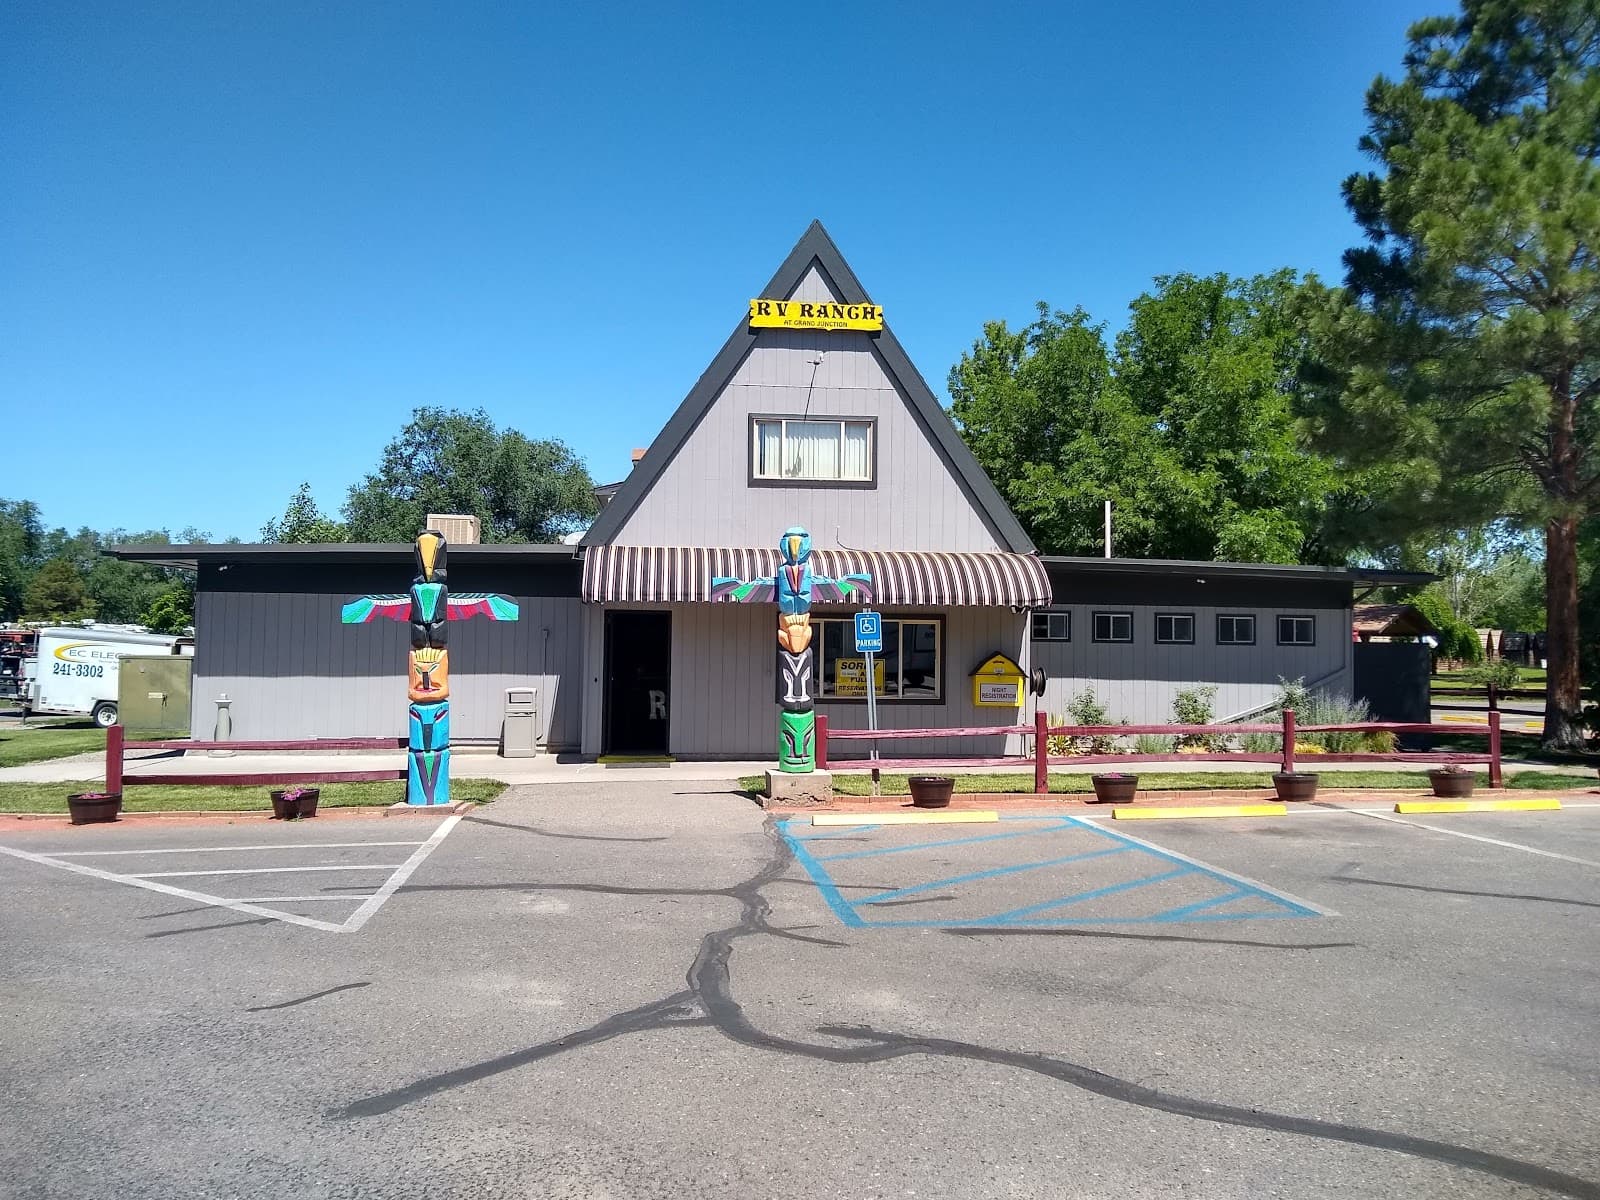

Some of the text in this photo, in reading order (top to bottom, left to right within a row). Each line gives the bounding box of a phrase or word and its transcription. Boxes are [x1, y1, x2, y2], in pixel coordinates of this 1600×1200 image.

[757, 302, 876, 320] RV RANCH
[69, 649, 87, 658] EC
[53, 662, 104, 678] 241-3302
[841, 662, 880, 670] SORY
